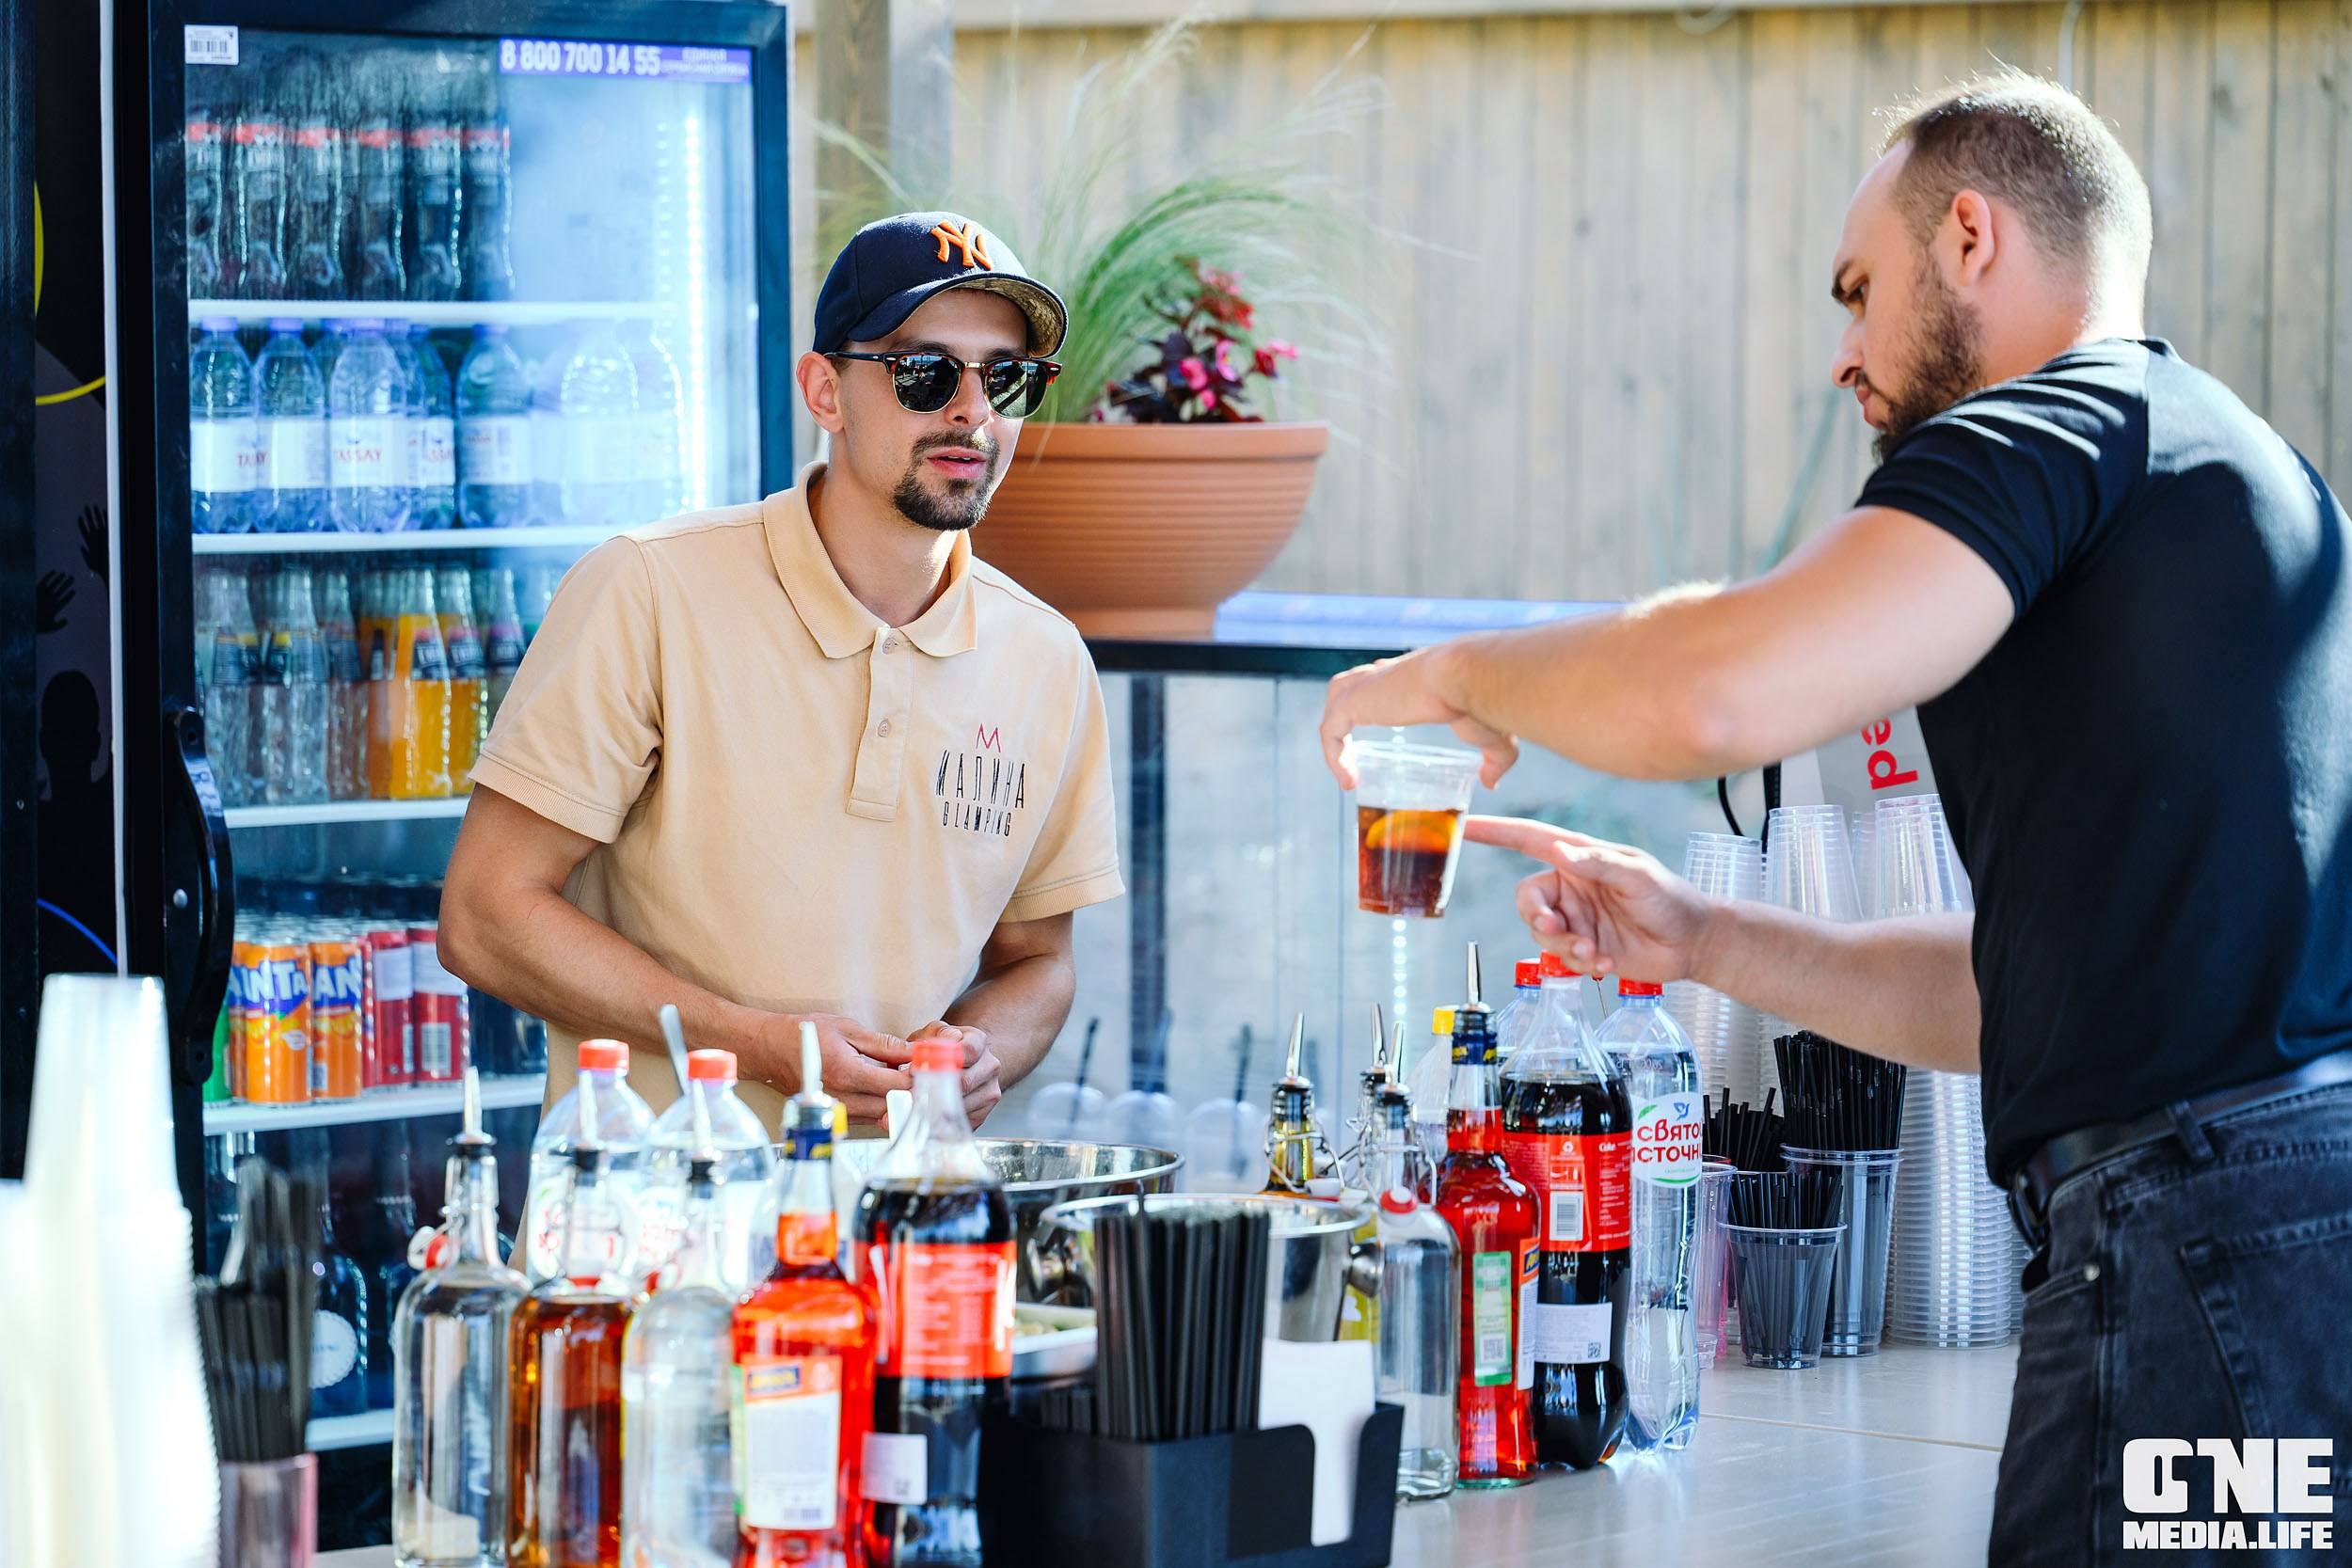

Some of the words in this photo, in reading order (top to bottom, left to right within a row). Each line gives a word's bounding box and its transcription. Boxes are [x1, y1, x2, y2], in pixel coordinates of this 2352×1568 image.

[501, 40, 516, 71] 8
[520, 40, 562, 71] 800
[564, 41, 604, 73] 700
[607, 43, 631, 75] 14
[634, 45, 662, 76] 55
[936, 750, 1025, 809] МАЛИНА
[943, 801, 1011, 836] GLAMPING
[1636, 1117, 1702, 1142] СВЯТО
[1631, 1144, 1702, 1164] СТОЧН
